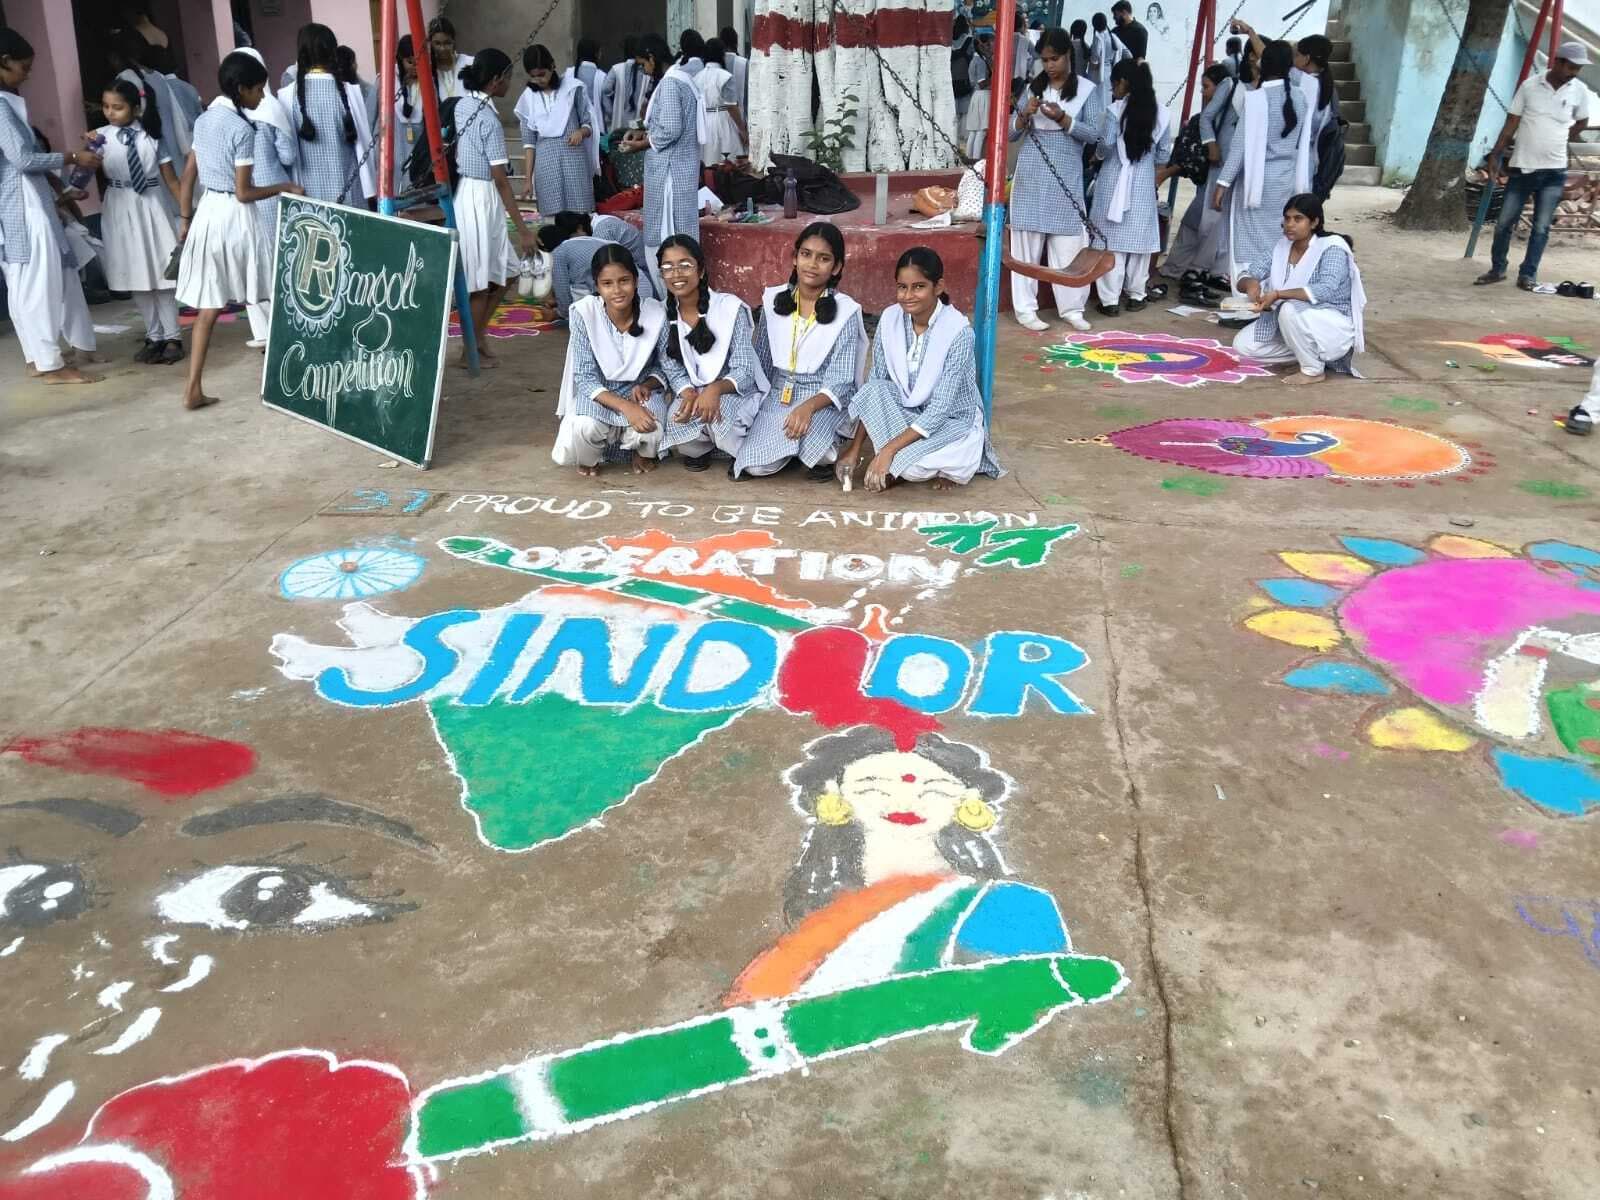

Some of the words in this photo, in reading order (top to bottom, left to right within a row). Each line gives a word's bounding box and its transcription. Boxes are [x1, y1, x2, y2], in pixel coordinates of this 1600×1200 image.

[296, 225, 424, 351] Rangoli
[280, 341, 415, 428] Competition
[445, 494, 612, 519] PROUD
[627, 501, 695, 518] TO
[712, 505, 785, 525] BE
[507, 546, 960, 588] OPERATION
[314, 609, 1095, 717] SINDOOR
